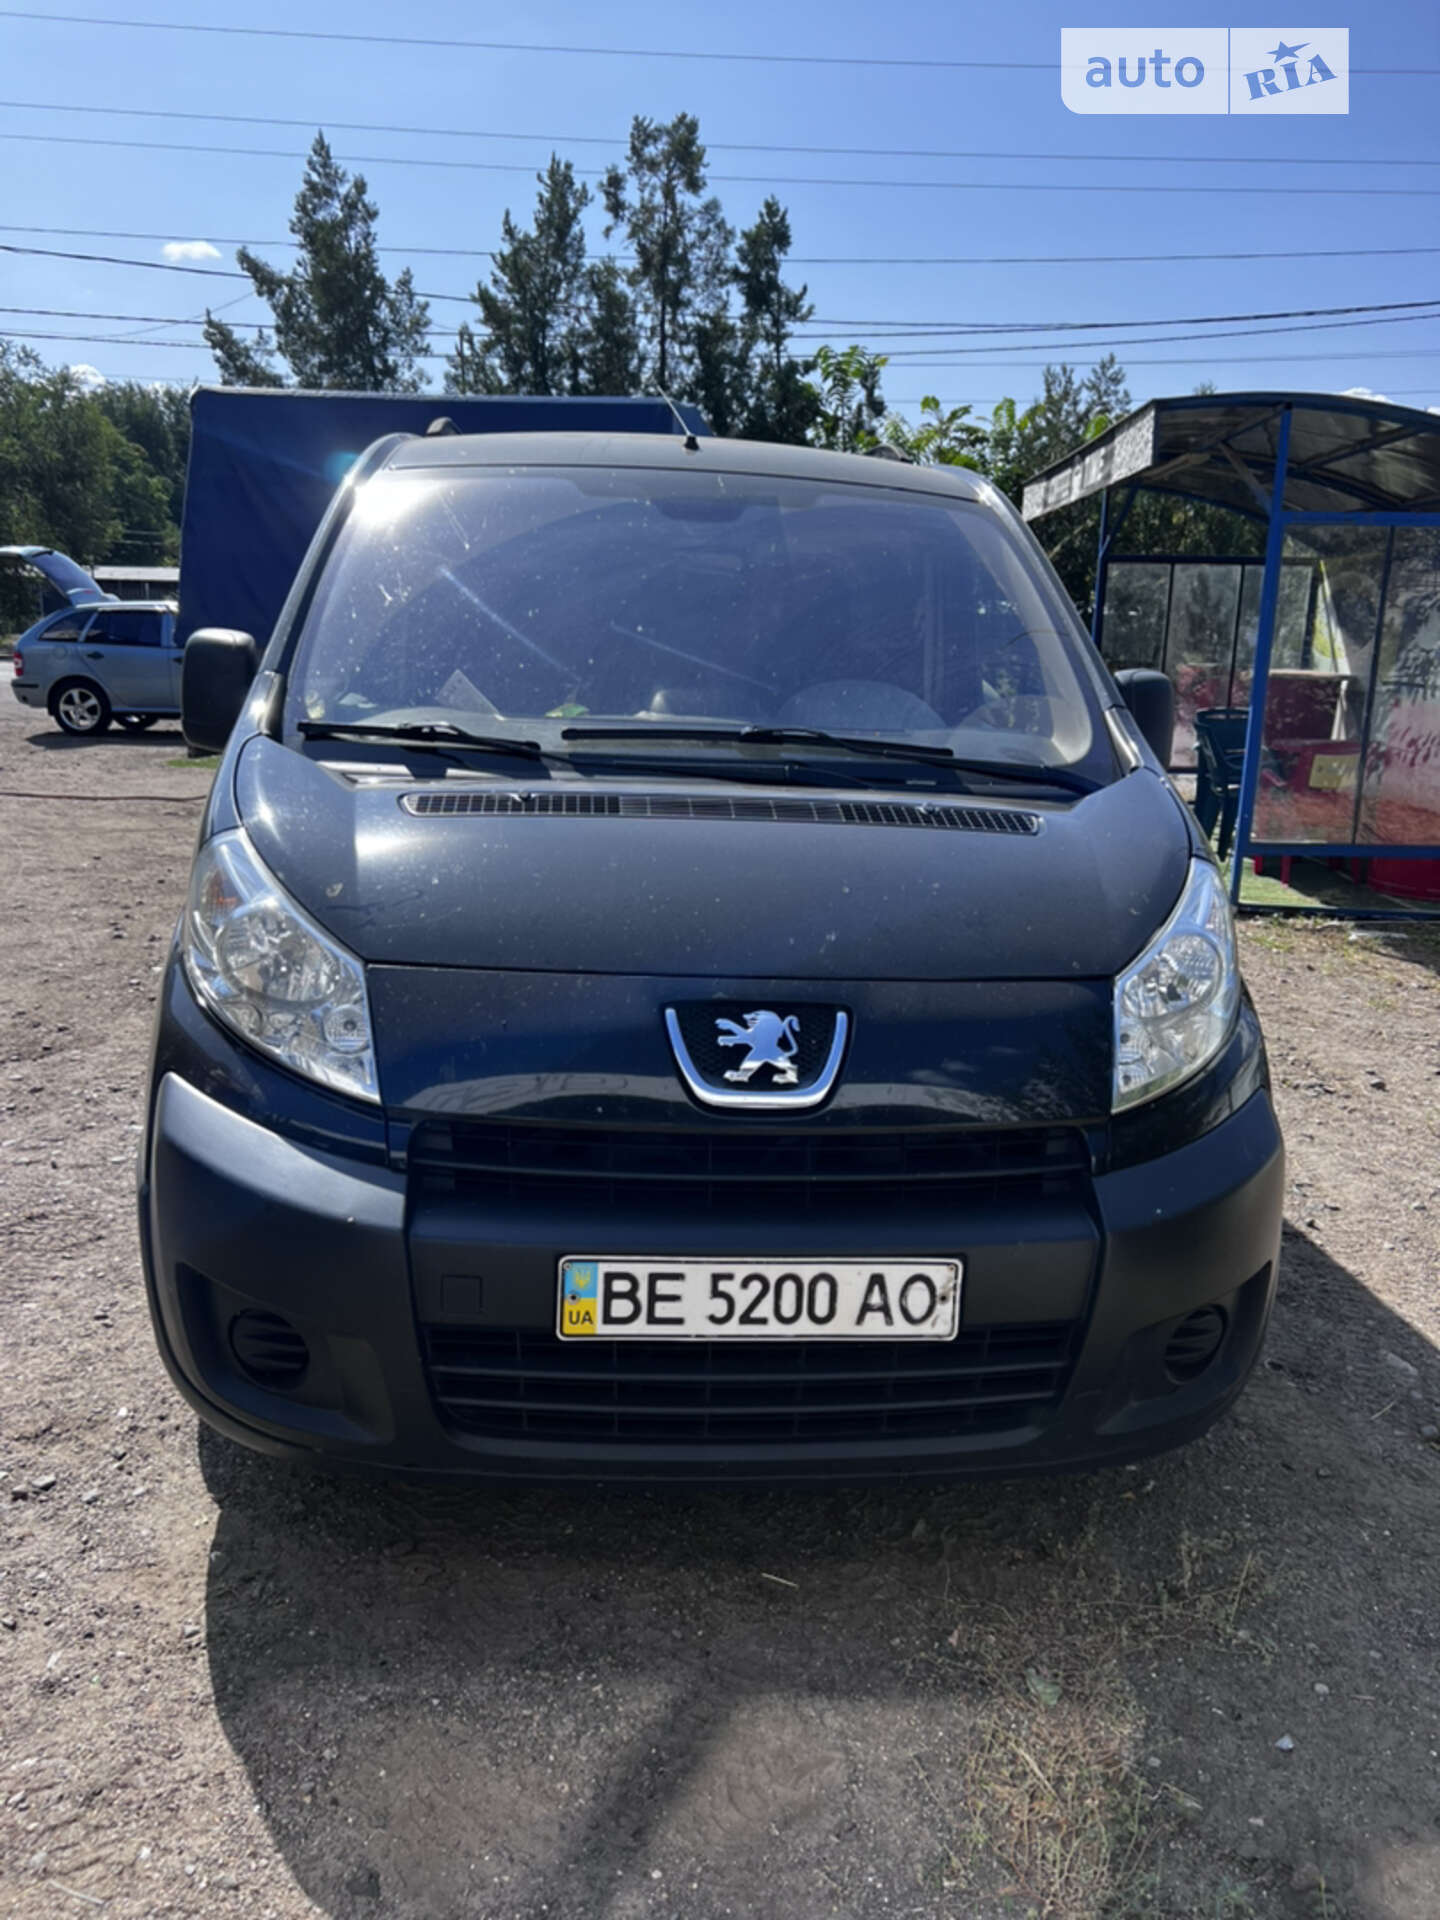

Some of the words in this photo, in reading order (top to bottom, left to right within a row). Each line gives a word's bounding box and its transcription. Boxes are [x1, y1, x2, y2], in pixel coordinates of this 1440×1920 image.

[602, 1271, 686, 1325] BE
[707, 1272, 838, 1325] 5200
[855, 1273, 938, 1326] AO
[568, 1310, 594, 1325] UA
